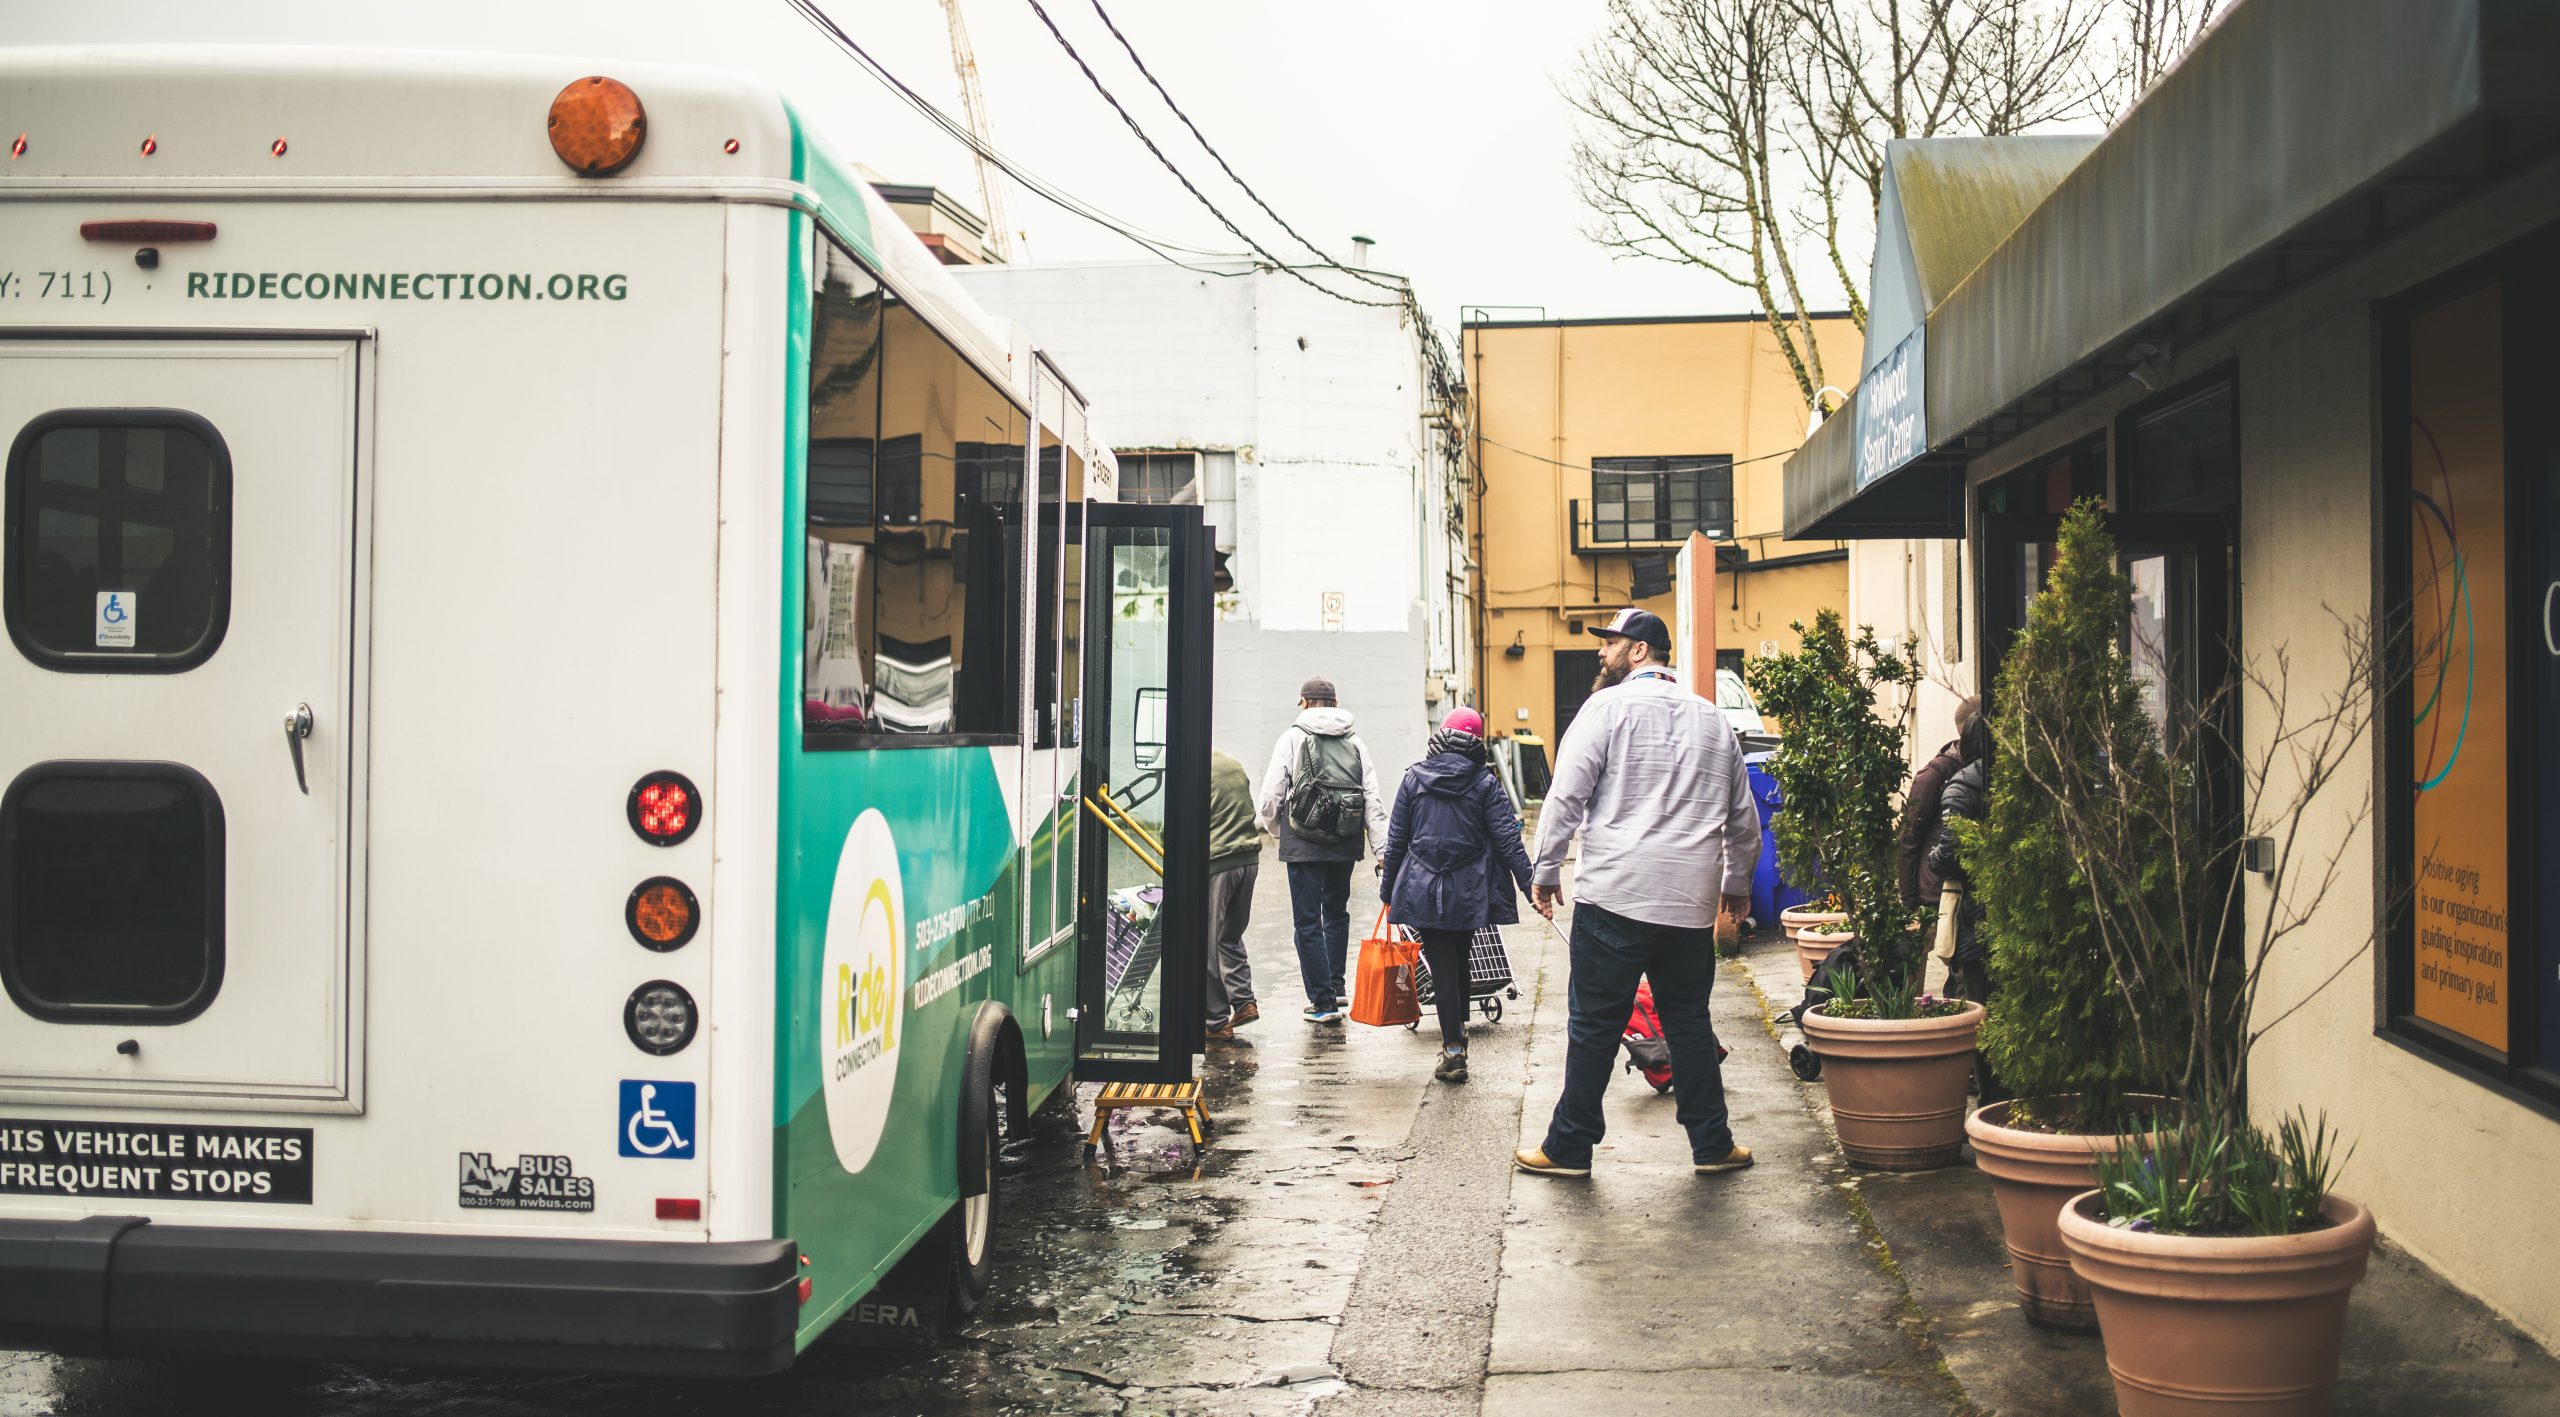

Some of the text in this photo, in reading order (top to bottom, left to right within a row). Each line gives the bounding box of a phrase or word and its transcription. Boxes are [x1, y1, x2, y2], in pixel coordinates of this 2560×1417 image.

[38, 271, 111, 304] 711)
[187, 272, 628, 301] RIDECONNECTION.ORG
[1870, 347, 1907, 426] Hollywood
[1864, 410, 1915, 479] Senior Center
[2422, 855, 2480, 895] Positive aging
[915, 903, 966, 950] 503-226-0700
[2421, 888, 2509, 934] is our organization's
[2421, 925, 2503, 970] guiding inspiration
[914, 944, 991, 1010] RIDECONNECTION.ORG
[2421, 960, 2499, 1005] and primary goal.
[836, 953, 885, 1050] Ride
[836, 1034, 882, 1081] CONNECTION
[54, 1131, 185, 1157] VEHICLE
[196, 1136, 302, 1161] MAKES
[520, 1156, 570, 1177] BUS
[0, 1163, 272, 1194] FREQUENT STOPS
[519, 1177, 592, 1197] SALES
[461, 1198, 592, 1209] 800-231-7099 nwbus.com
